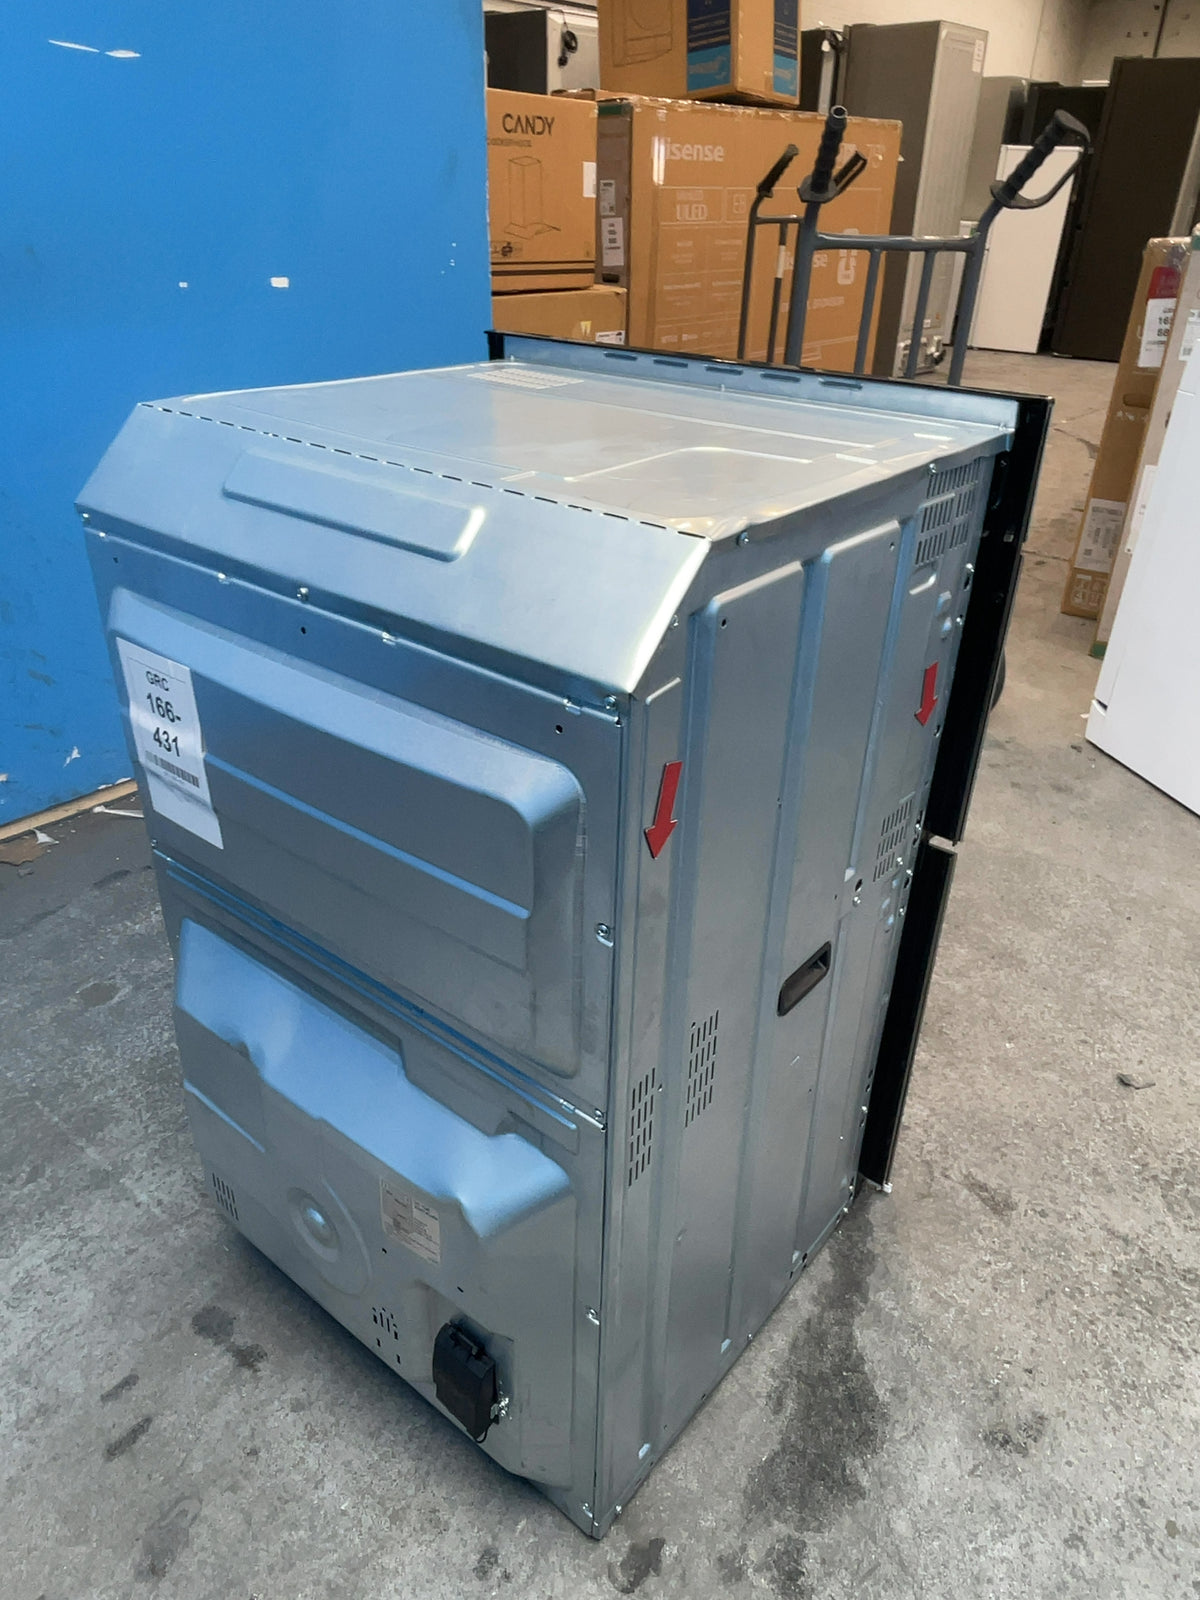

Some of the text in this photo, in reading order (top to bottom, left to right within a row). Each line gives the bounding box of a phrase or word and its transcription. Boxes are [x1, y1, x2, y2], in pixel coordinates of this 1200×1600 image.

[502, 113, 555, 136] CANDY
[145, 671, 170, 692] GRC
[146, 692, 182, 723] 166-
[153, 726, 181, 758] 431
